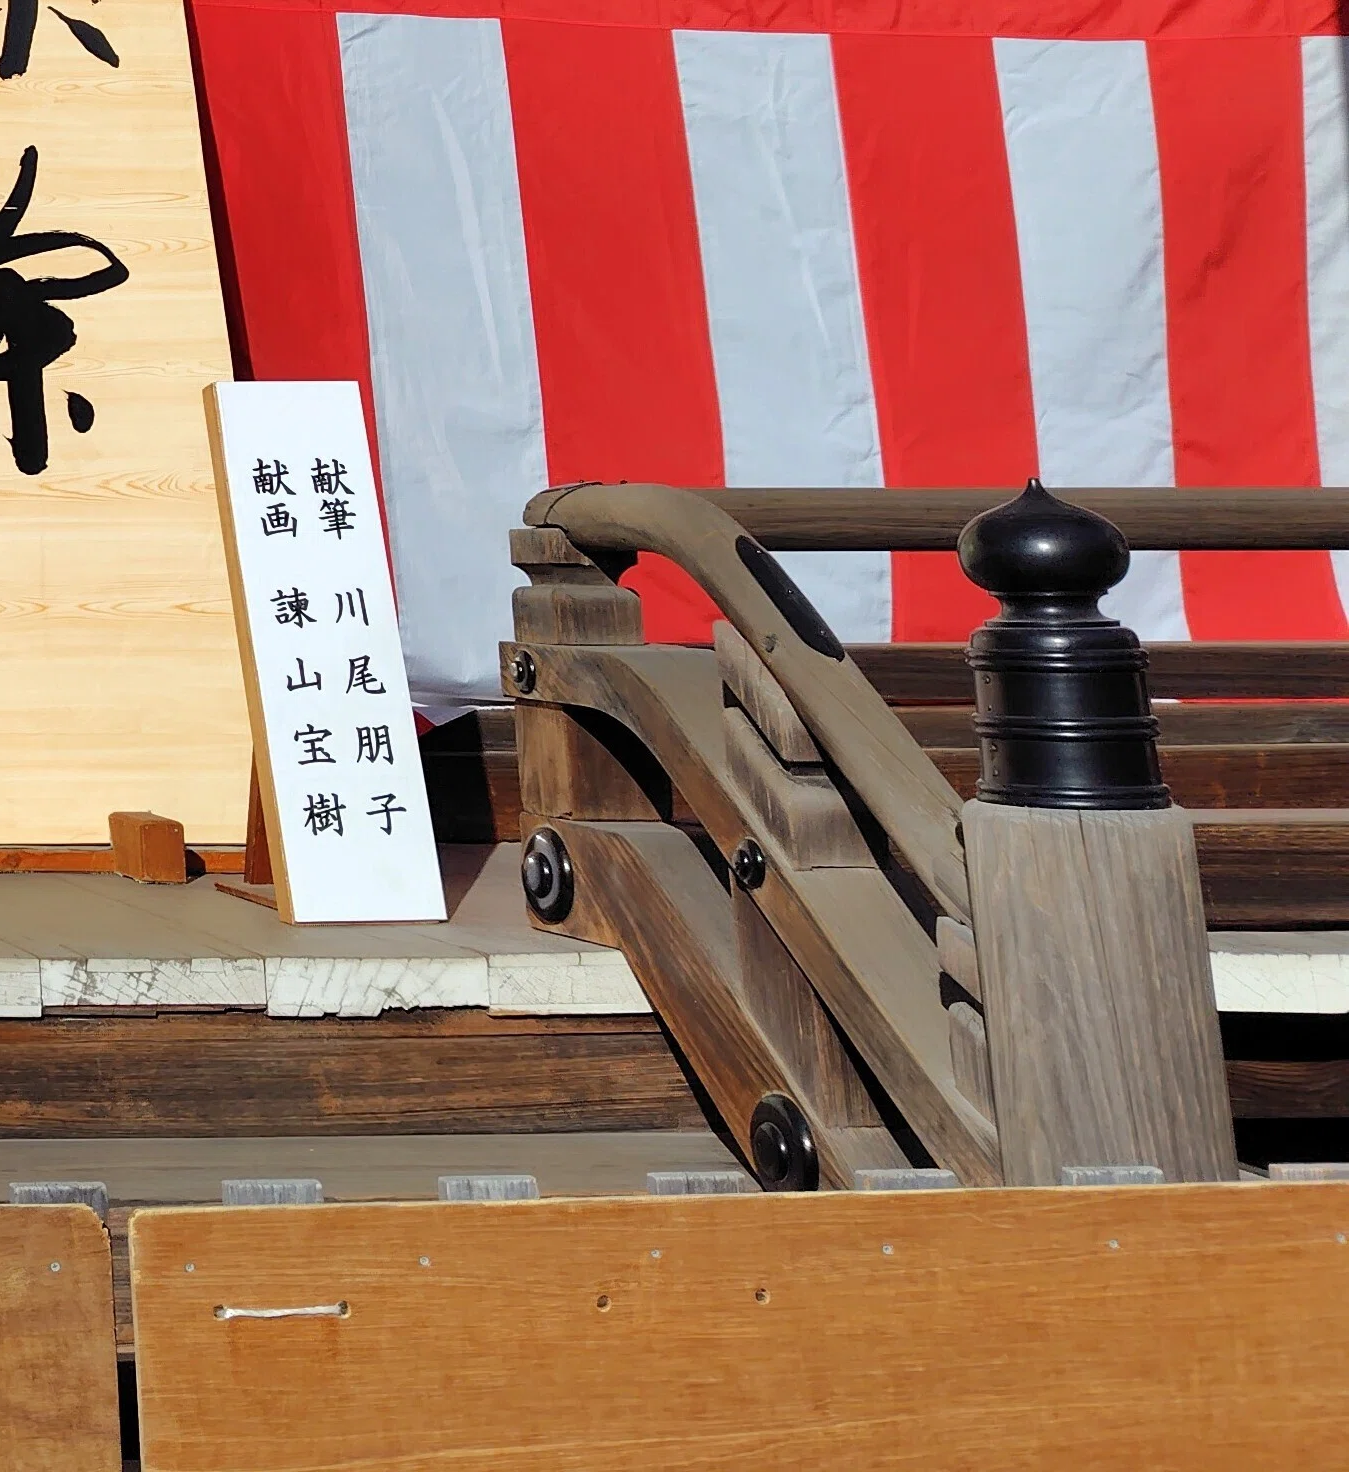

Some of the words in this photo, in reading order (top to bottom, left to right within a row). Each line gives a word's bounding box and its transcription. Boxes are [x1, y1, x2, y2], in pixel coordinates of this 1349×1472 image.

[251, 457, 299, 540] 献画
[311, 456, 356, 541] 献筆
[334, 586, 408, 836] 川尾朋子
